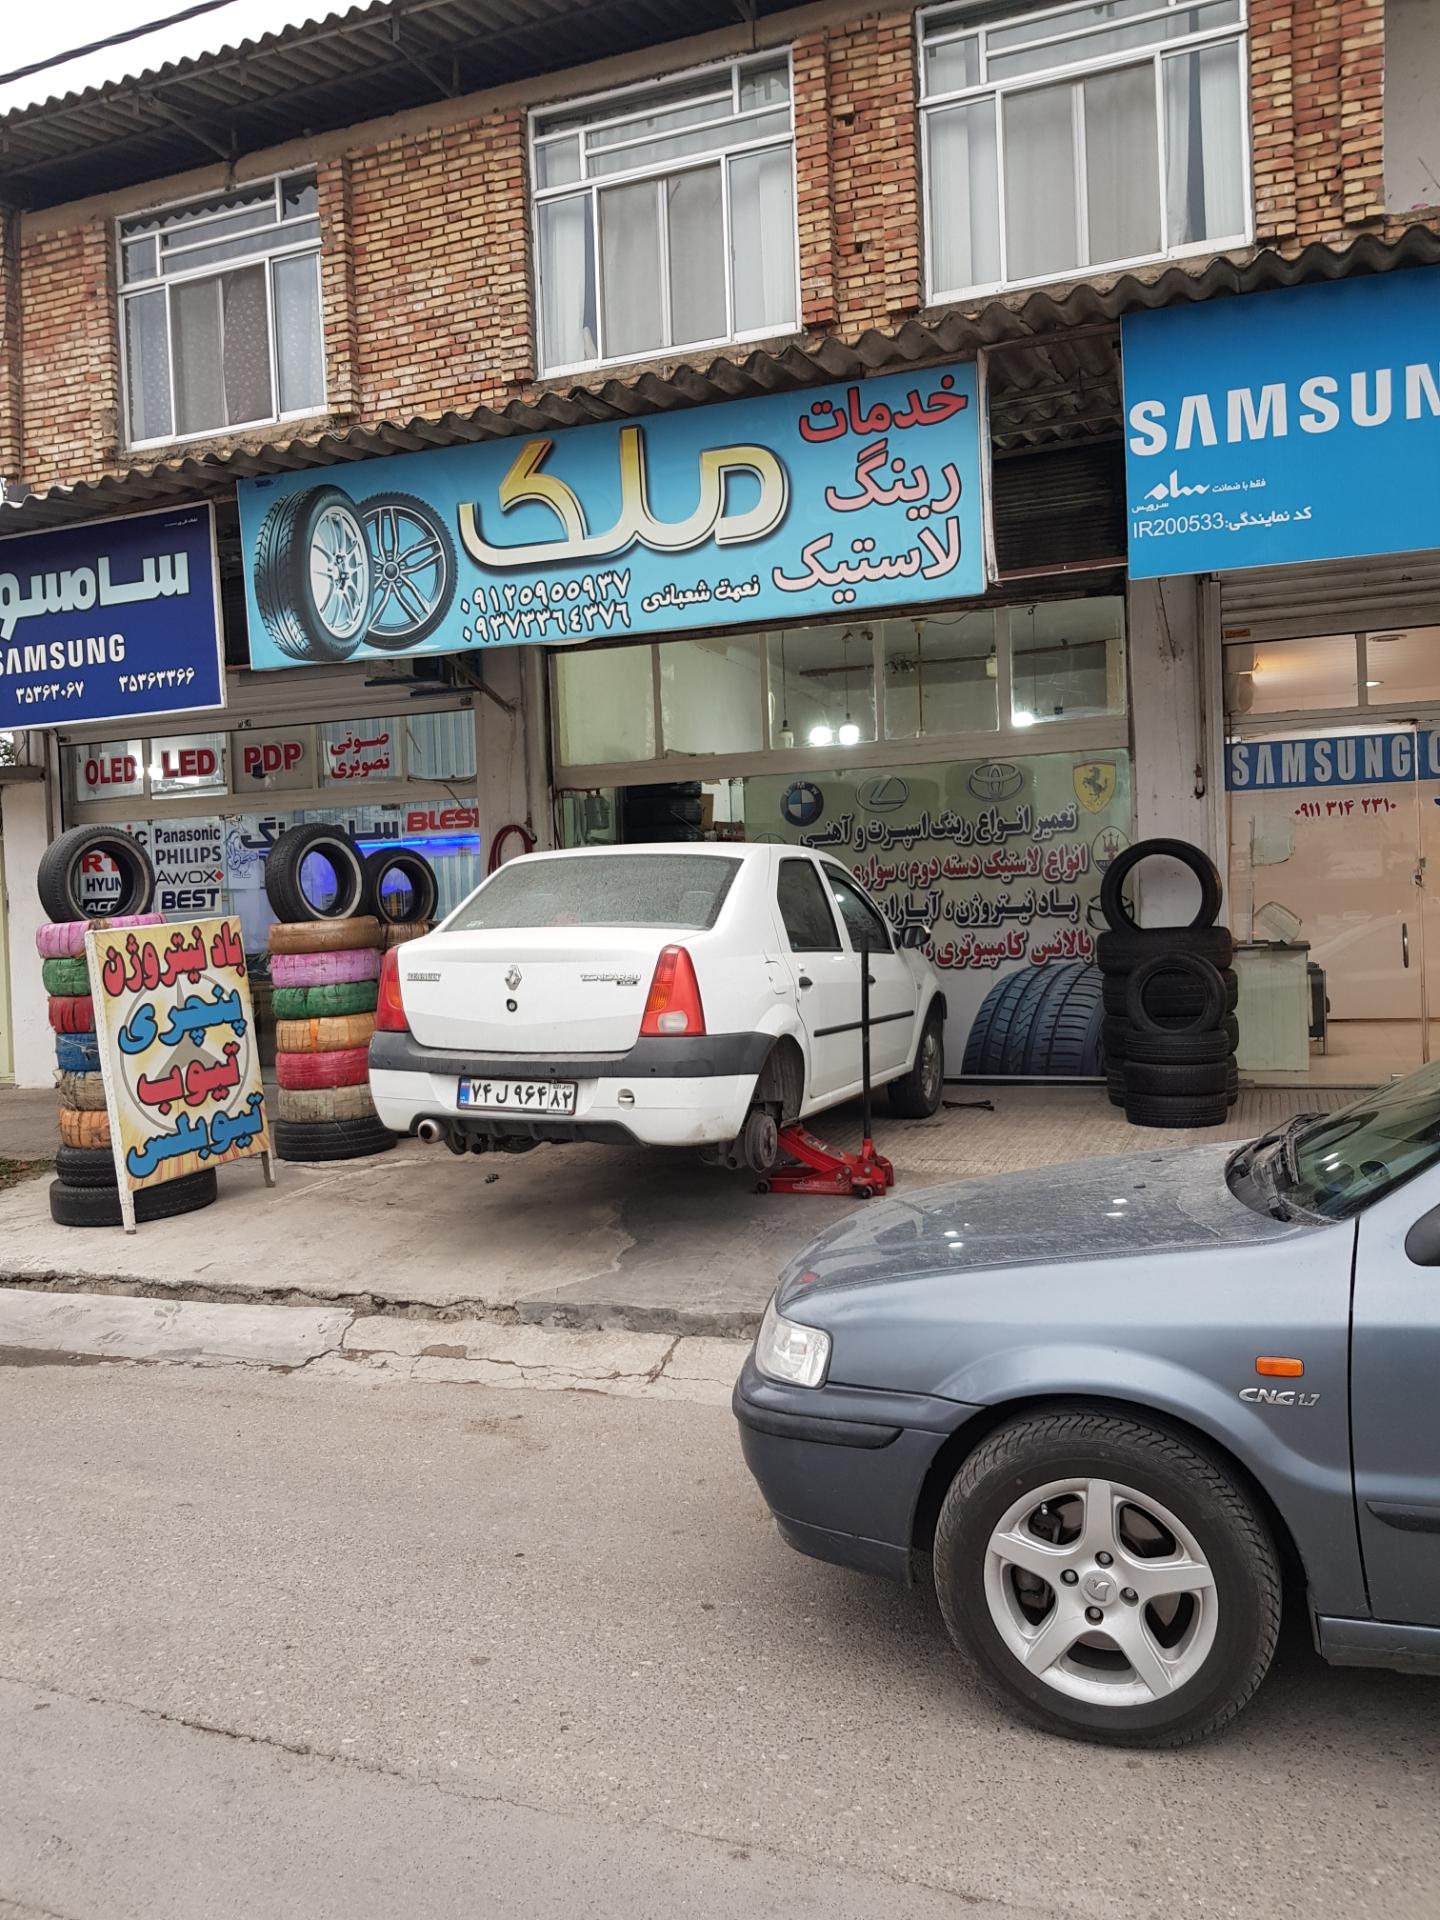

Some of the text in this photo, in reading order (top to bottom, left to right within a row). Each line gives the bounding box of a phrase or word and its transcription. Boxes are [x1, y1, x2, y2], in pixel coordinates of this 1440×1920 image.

[800, 375, 969, 443] خدمات
[457, 425, 791, 566] ملک
[825, 439, 962, 521] رینگ
[1133, 512, 1225, 538] IR200533
[1293, 506, 1312, 520] کد
[772, 516, 961, 603] لاستیک
[642, 576, 761, 612] نعمت شعبانی
[0, 633, 126, 677] AMSUNG
[243, 743, 302, 774] PDP
[330, 731, 390, 755] صوتی
[1231, 734, 1411, 786] SAMSUNG
[84, 755, 138, 785] OLED
[161, 748, 217, 779] LED
[330, 752, 390, 779] تصویری
[975, 804, 1032, 843] انواع
[1032, 802, 1078, 840] تعمیر
[1294, 797, 1397, 817] ۰۹۱۱ ۳۱۴ ۲۳۱۰
[155, 825, 221, 844] Panasonic
[853, 824, 866, 850] و
[866, 810, 930, 850] اسپرت
[930, 810, 974, 845] رینگ
[156, 846, 222, 865] PHILIPS
[942, 852, 983, 879] دسته
[982, 847, 1042, 883] لاستیک
[1043, 843, 1089, 882] انواع
[156, 869, 217, 886] AWOX
[161, 888, 220, 910] BEST
[1037, 886, 1079, 922] باد
[103, 921, 245, 997] باد نیتروژن
[1028, 927, 1094, 965] بالانس
[118, 984, 247, 1055] پنچری
[137, 1041, 241, 1115] تیوب
[126, 1092, 264, 1178] تیوبلس
[1238, 1387, 1321, 1407] CNG 1.7
